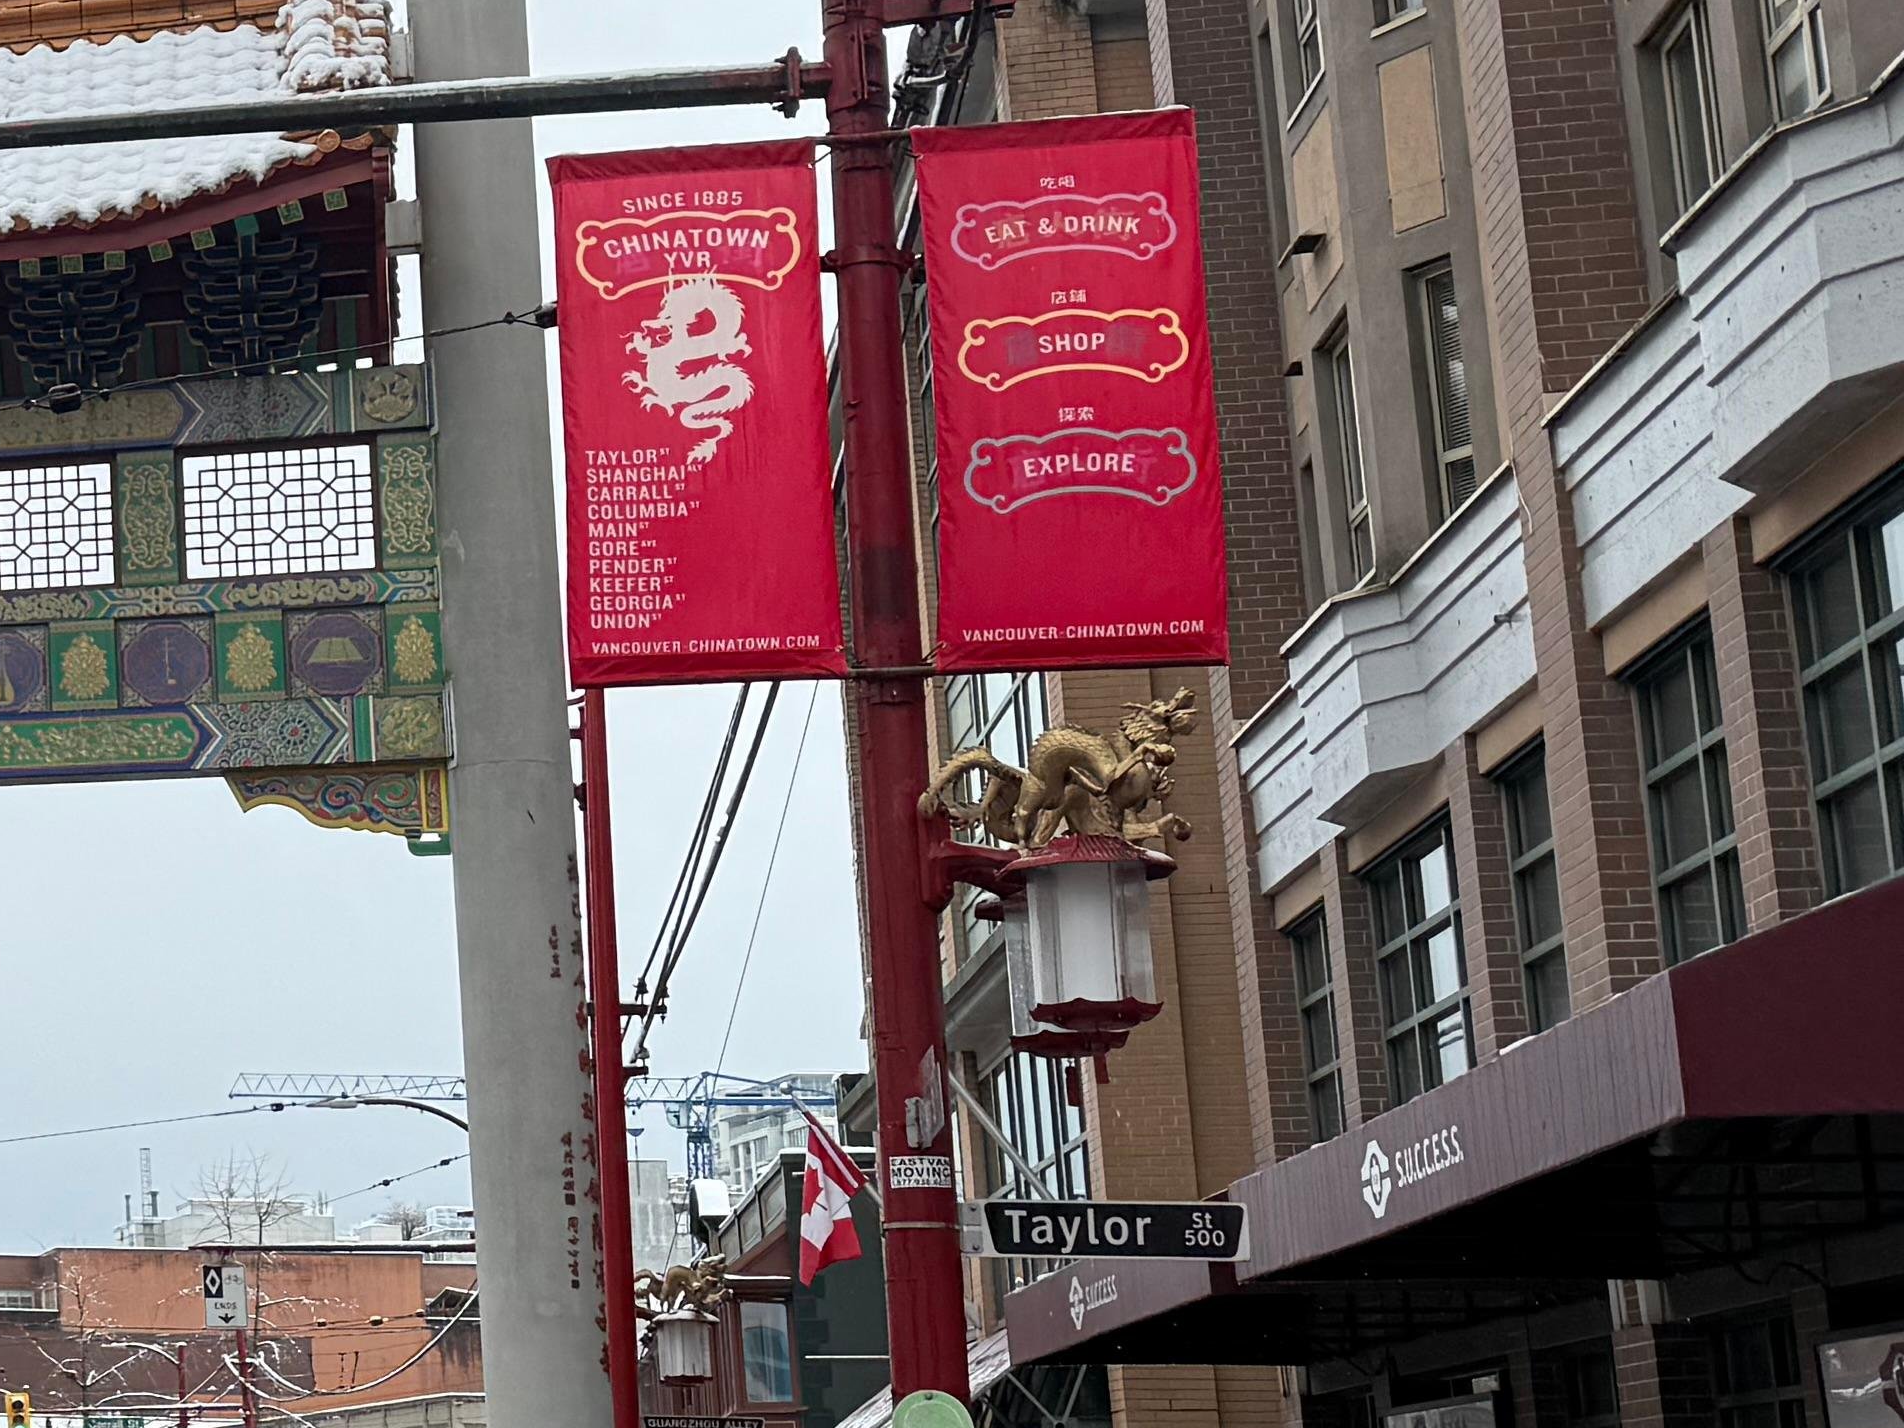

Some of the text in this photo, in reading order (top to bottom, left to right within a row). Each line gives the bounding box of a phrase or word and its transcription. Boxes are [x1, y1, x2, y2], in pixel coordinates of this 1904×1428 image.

[622, 191, 743, 214] SINCE 1885
[985, 215, 1141, 244] EAT & DRINK
[603, 228, 770, 259] CHINATOWN
[664, 250, 711, 269] YVR
[1038, 332, 1106, 354] SHOP
[585, 449, 657, 466] TAYLOR
[1023, 453, 1136, 478] EXPLORE
[586, 466, 685, 484] SHANGHAI
[587, 483, 672, 502] CARRALL
[588, 502, 688, 520] COLUMBIA
[588, 522, 637, 538] MAIN
[589, 540, 639, 557] GORE
[589, 558, 665, 574] PENDER
[589, 576, 661, 593] KEEFER
[590, 594, 673, 612] GEORGIA
[590, 613, 650, 629] UNION
[962, 619, 1205, 643] VANCOUVER-CHINATOWN.COM
[1005, 1209, 1213, 1253] Taylor St
[1184, 1229, 1225, 1246] 500
[648, 1418, 720, 1428] GUANGZHOU
